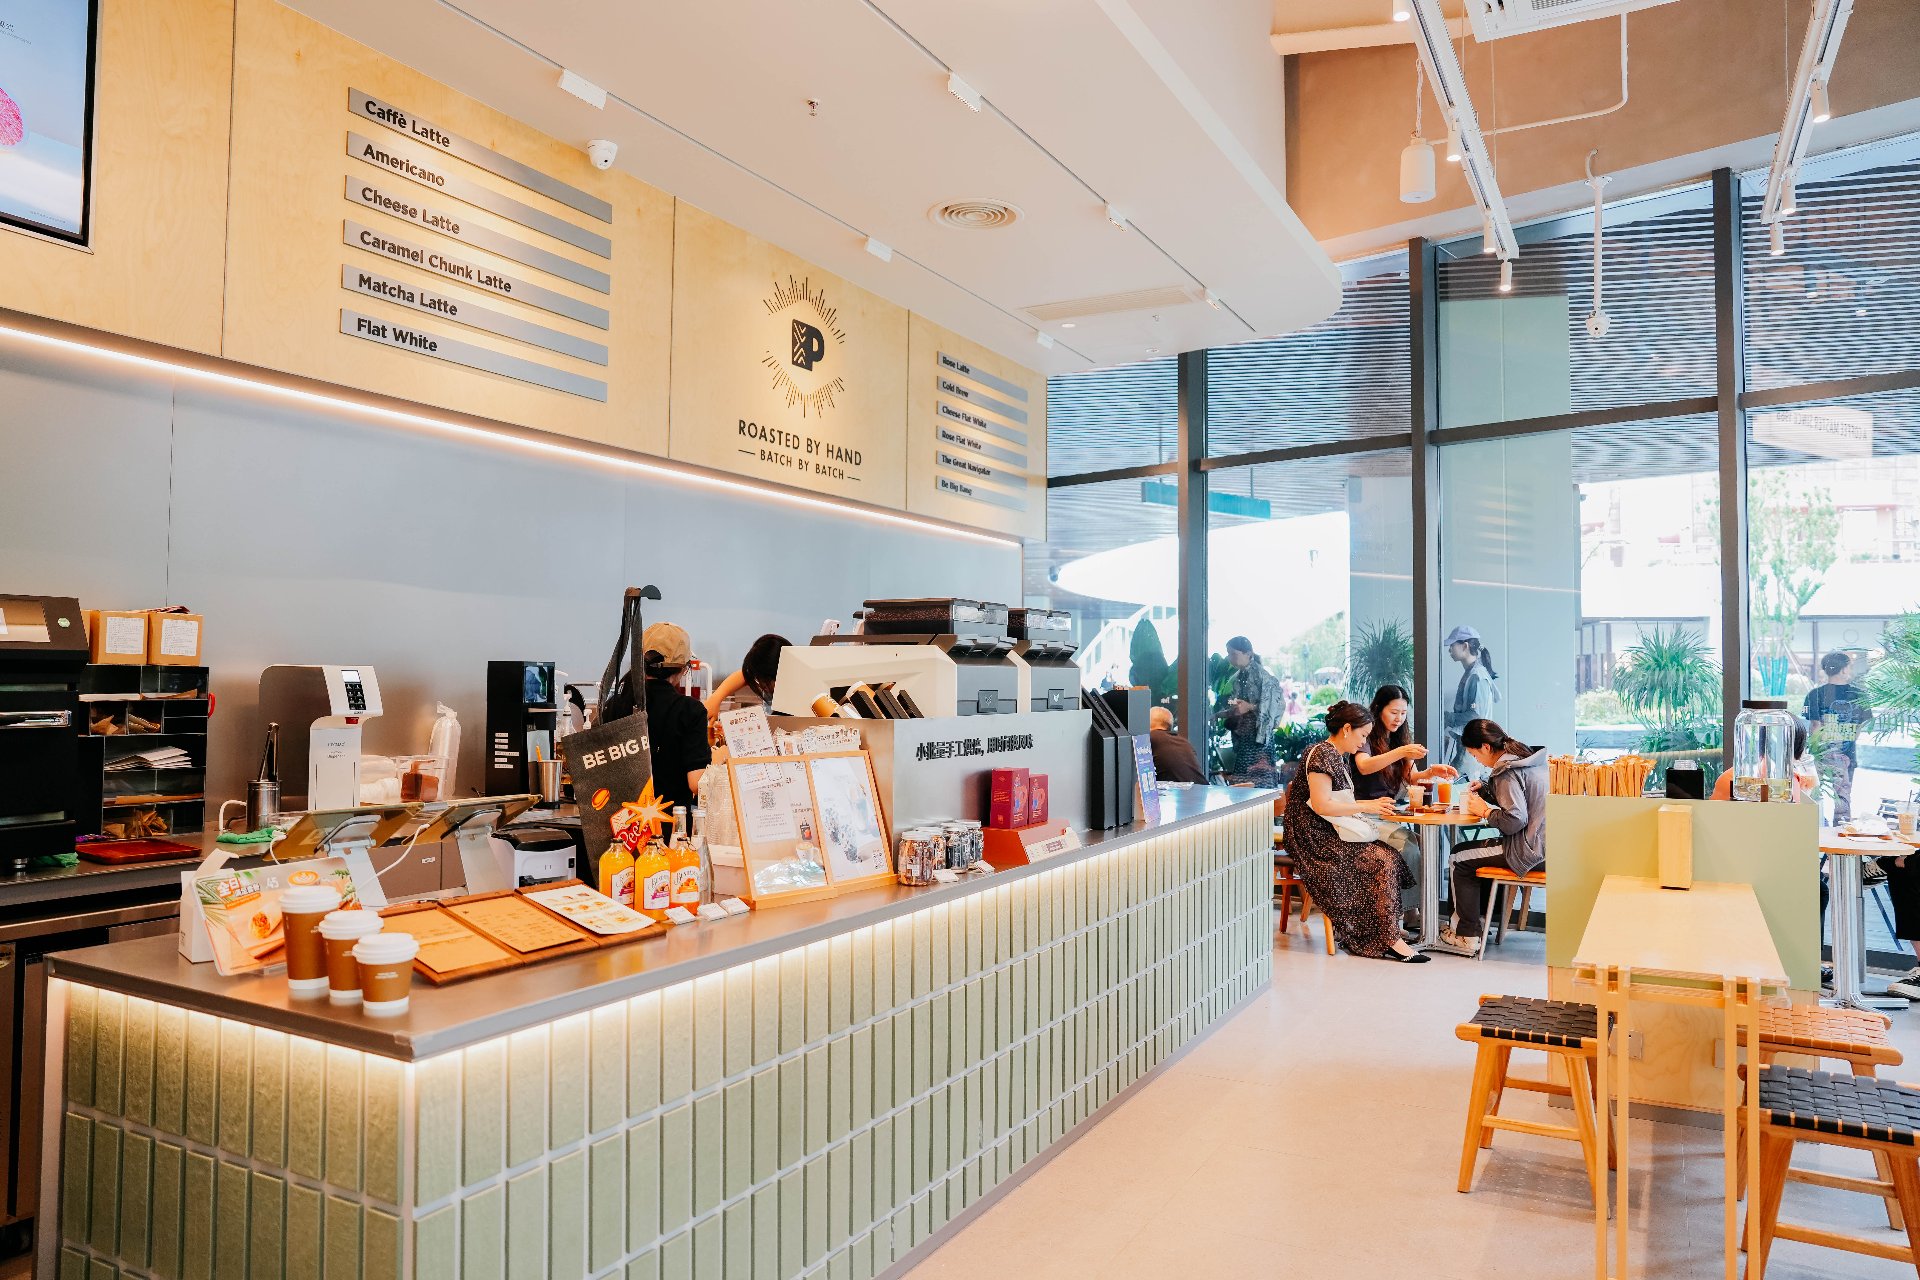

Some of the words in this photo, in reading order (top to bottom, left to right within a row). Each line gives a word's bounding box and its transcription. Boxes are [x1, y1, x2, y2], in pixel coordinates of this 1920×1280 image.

[365, 100, 407, 128] Caffè
[411, 120, 450, 148] Latte
[363, 143, 445, 187] Americano
[361, 187, 418, 219] Cheese
[422, 209, 460, 234] Latte
[360, 230, 424, 264] Caramel
[428, 254, 473, 280] Chunk
[477, 269, 512, 293] Latte
[358, 273, 415, 303] Matcha
[420, 292, 458, 316] Latte
[357, 318, 387, 339] Flat
[392, 327, 438, 352] White
[956, 362, 970, 374] Latte
[942, 381, 955, 393] Cold
[942, 406, 961, 419] Cheese
[961, 413, 972, 423] Flat
[972, 416, 987, 429] White
[738, 419, 800, 450] ROASTED
[806, 438, 821, 456] BY
[827, 443, 862, 466] HAND
[941, 430, 955, 442] Rose
[956, 435, 966, 445] Flat
[966, 438, 981, 450] White
[760, 450, 792, 467] BATCH
[798, 458, 809, 472] BY
[815, 463, 844, 480] BATCH
[941, 454, 952, 465] The
[952, 458, 967, 470] Great
[967, 462, 991, 476] Navigator
[941, 479, 949, 489] Be
[949, 481, 959, 492] Big
[582, 749, 608, 770] BE
[608, 739, 640, 762] BIG
